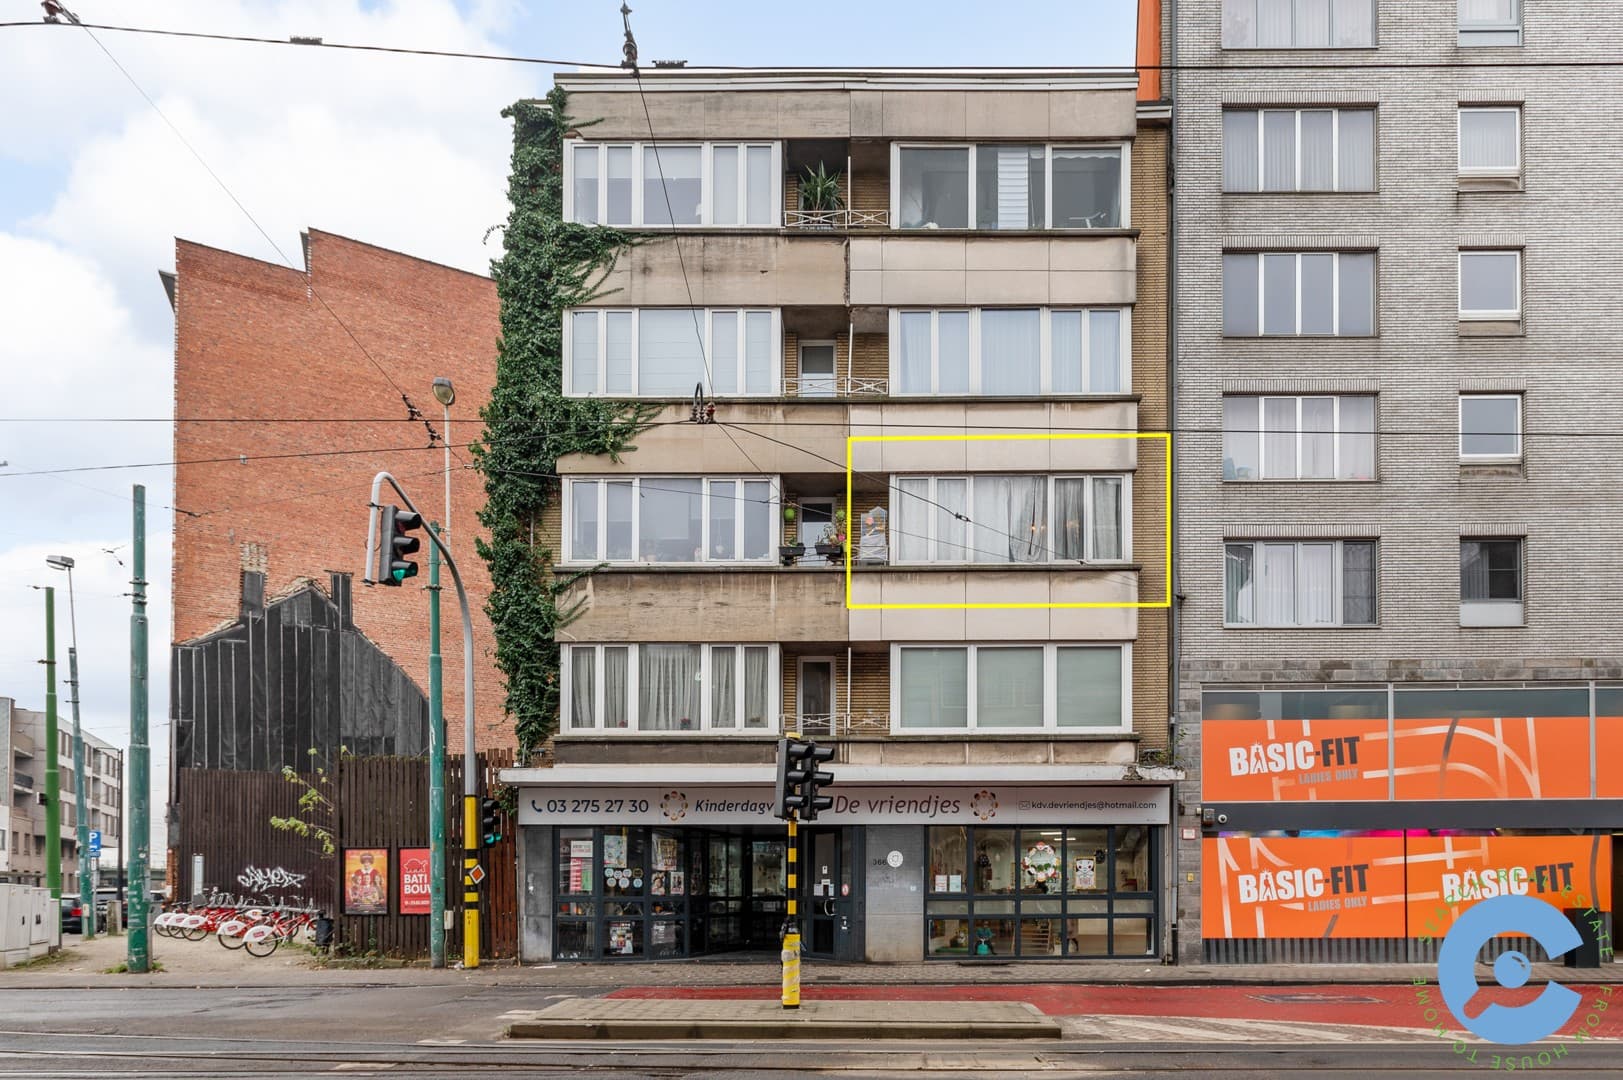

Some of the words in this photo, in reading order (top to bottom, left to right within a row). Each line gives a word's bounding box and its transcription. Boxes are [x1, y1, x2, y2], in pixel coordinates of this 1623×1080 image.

[1228, 736, 1360, 776] BASIC-FIT
[1299, 770, 1332, 784] LADIES
[1335, 768, 1359, 781] ONLY
[546, 799, 567, 813] 03
[571, 799, 600, 813] 275
[604, 799, 624, 813] 27
[628, 799, 649, 813] 30
[695, 798, 775, 815] Kinderdagv
[835, 796, 859, 813] De
[868, 795, 961, 818] vriendjes
[1031, 800, 1157, 811] kdv.devriendjes@hotmail.com
[89, 832, 98, 843] P
[404, 874, 428, 884] BATI
[1238, 864, 1369, 903] BASIC-FIT
[1442, 862, 1574, 903] BASIC-FIT
[1308, 898, 1341, 912] LADIES
[1344, 896, 1368, 908] ONLY
